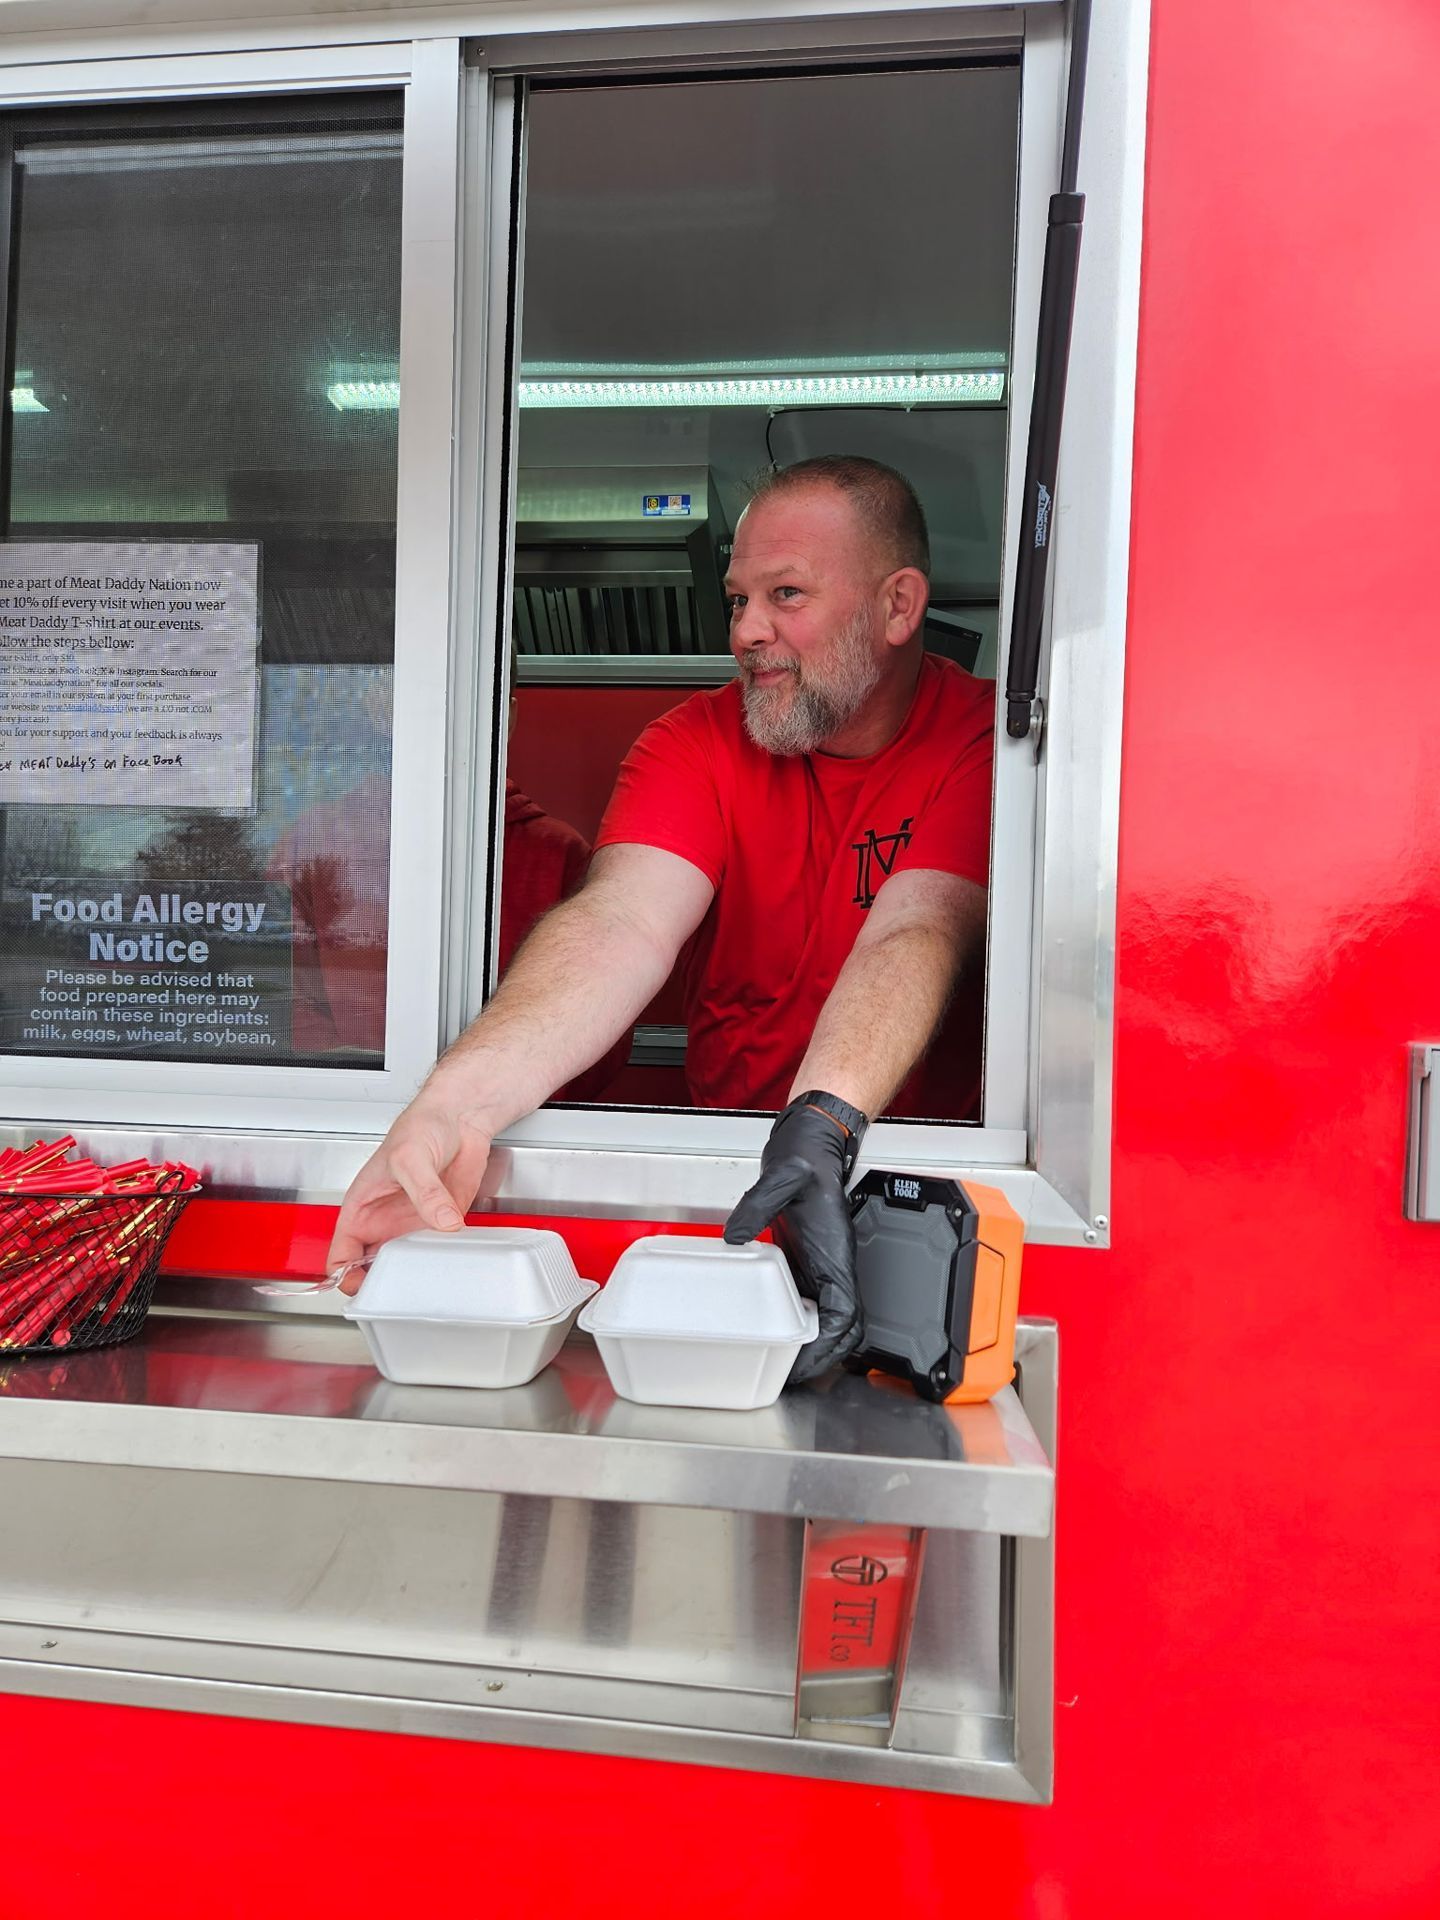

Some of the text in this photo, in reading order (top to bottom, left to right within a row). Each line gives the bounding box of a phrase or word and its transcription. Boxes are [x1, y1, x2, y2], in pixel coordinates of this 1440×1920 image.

[17, 580, 24, 588] a
[27, 578, 52, 591] part
[54, 576, 68, 589] of
[70, 577, 101, 589] Meat
[105, 577, 146, 593] Daddy
[149, 579, 191, 591] Nation
[194, 581, 221, 590] now
[14, 597, 39, 608] 10%
[42, 596, 59, 608] off
[62, 599, 97, 611] every
[100, 597, 127, 609] visit
[130, 598, 165, 610] when
[169, 601, 192, 613] you
[195, 601, 226, 610] wear
[30, 616, 68, 630] Daddy
[72, 616, 116, 629] T-shirt
[120, 619, 132, 629] at
[134, 620, 156, 629] our
[158, 619, 204, 630] events.
[32, 635, 52, 647] the
[53, 637, 86, 650] steps
[89, 636, 134, 649] bellow:
[161, 668, 188, 677] Search
[190, 668, 202, 677] for
[110, 680, 119, 688] all
[77, 693, 105, 701] system
[15, 728, 28, 737] for
[30, 730, 51, 739] your
[53, 730, 88, 740] support
[91, 729, 108, 738] and
[110, 731, 131, 740] your
[134, 729, 177, 739] feedback
[179, 730, 187, 739] is
[188, 730, 223, 742] always
[104, 759, 117, 769] on
[32, 893, 266, 932] Food Allergy
[89, 932, 209, 963] Notice
[46, 970, 254, 988] Please be advised that
[40, 988, 260, 1010] food prepared here may
[31, 1007, 269, 1027] contain these ingredients:
[24, 1025, 277, 1046] milk, eggs, wheat, soybean,
[894, 1188, 919, 1199] TOOLS
[832, 1597, 877, 1648] TFT
